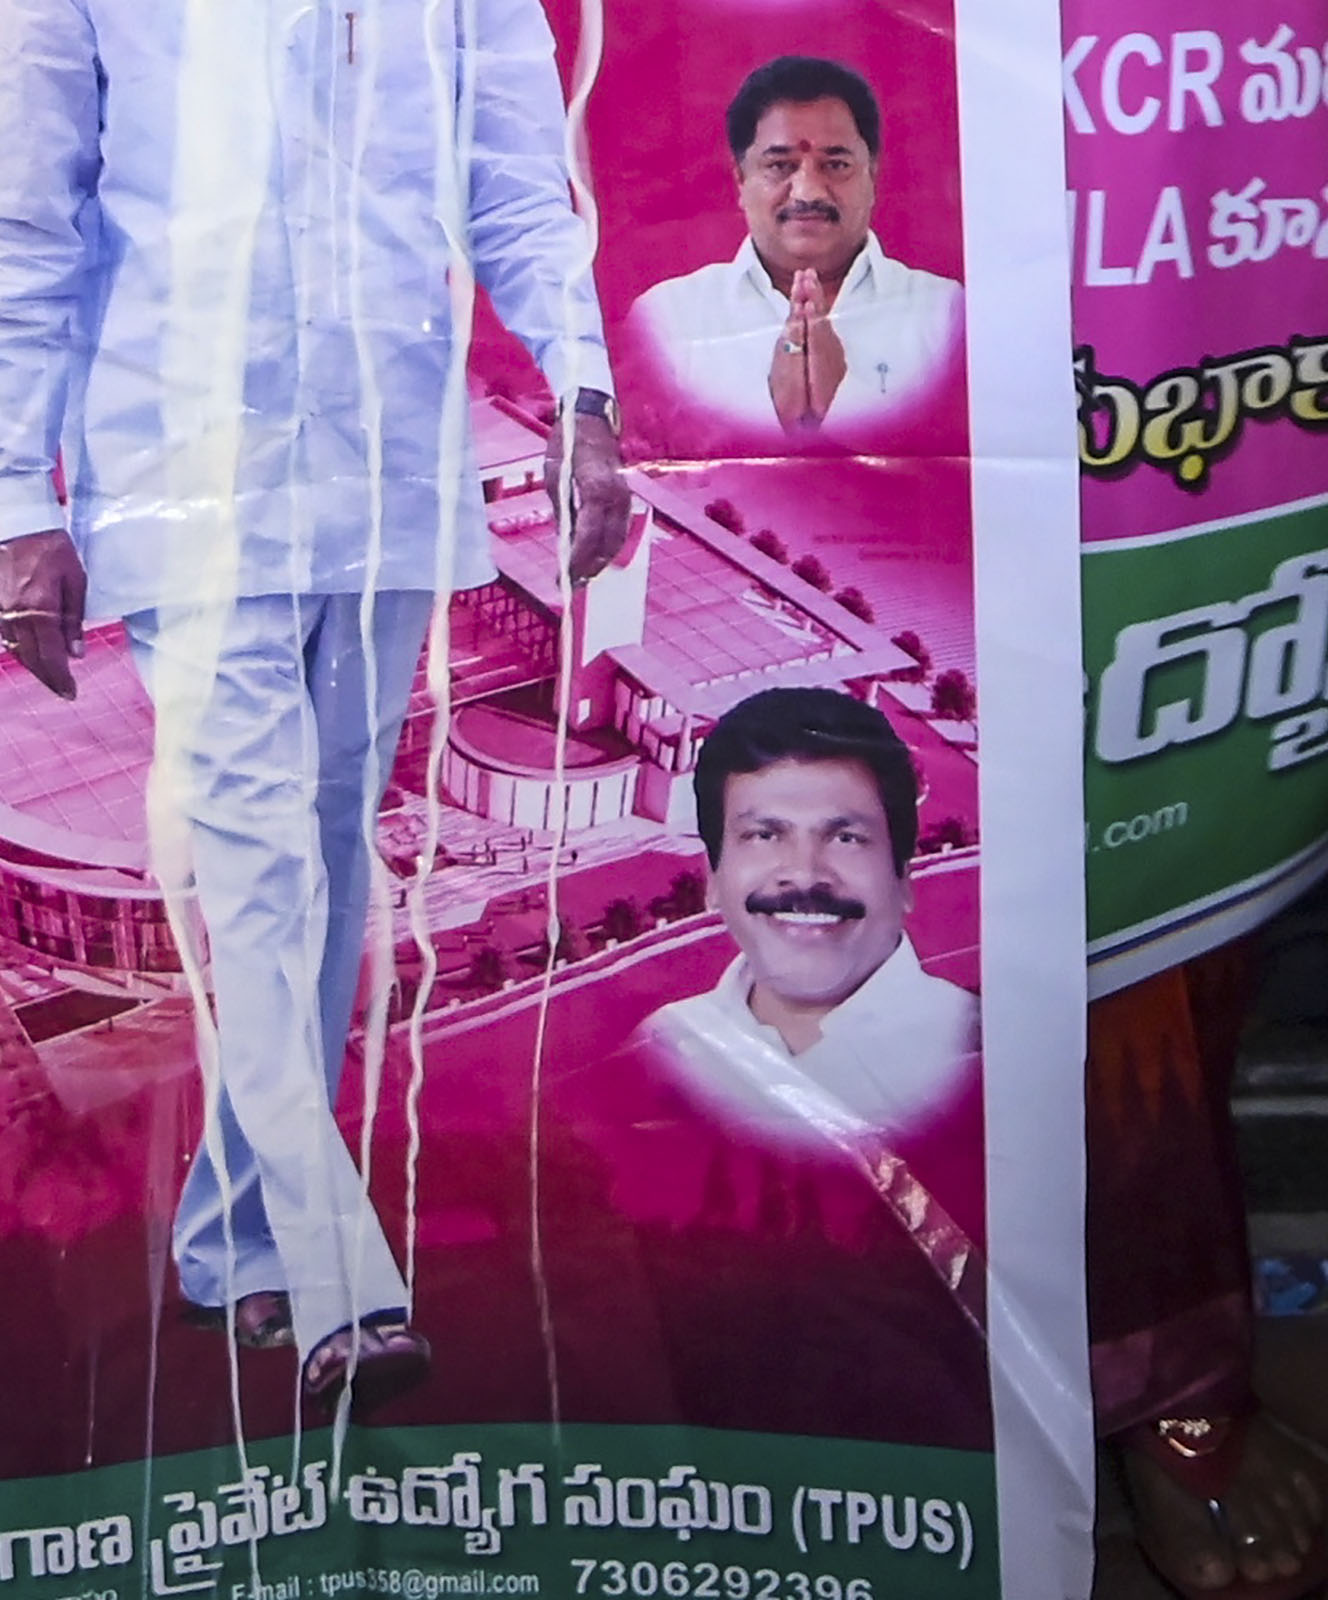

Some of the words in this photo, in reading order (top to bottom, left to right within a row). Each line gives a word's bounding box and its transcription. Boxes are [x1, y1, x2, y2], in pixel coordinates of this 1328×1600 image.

[1065, 186, 1195, 287] LA
[342, 1452, 548, 1556] ఉద్యోగ
[563, 1463, 773, 1542] సంఘం
[792, 1486, 973, 1571] (TPUS)
[570, 1559, 873, 1600] 7306292396
